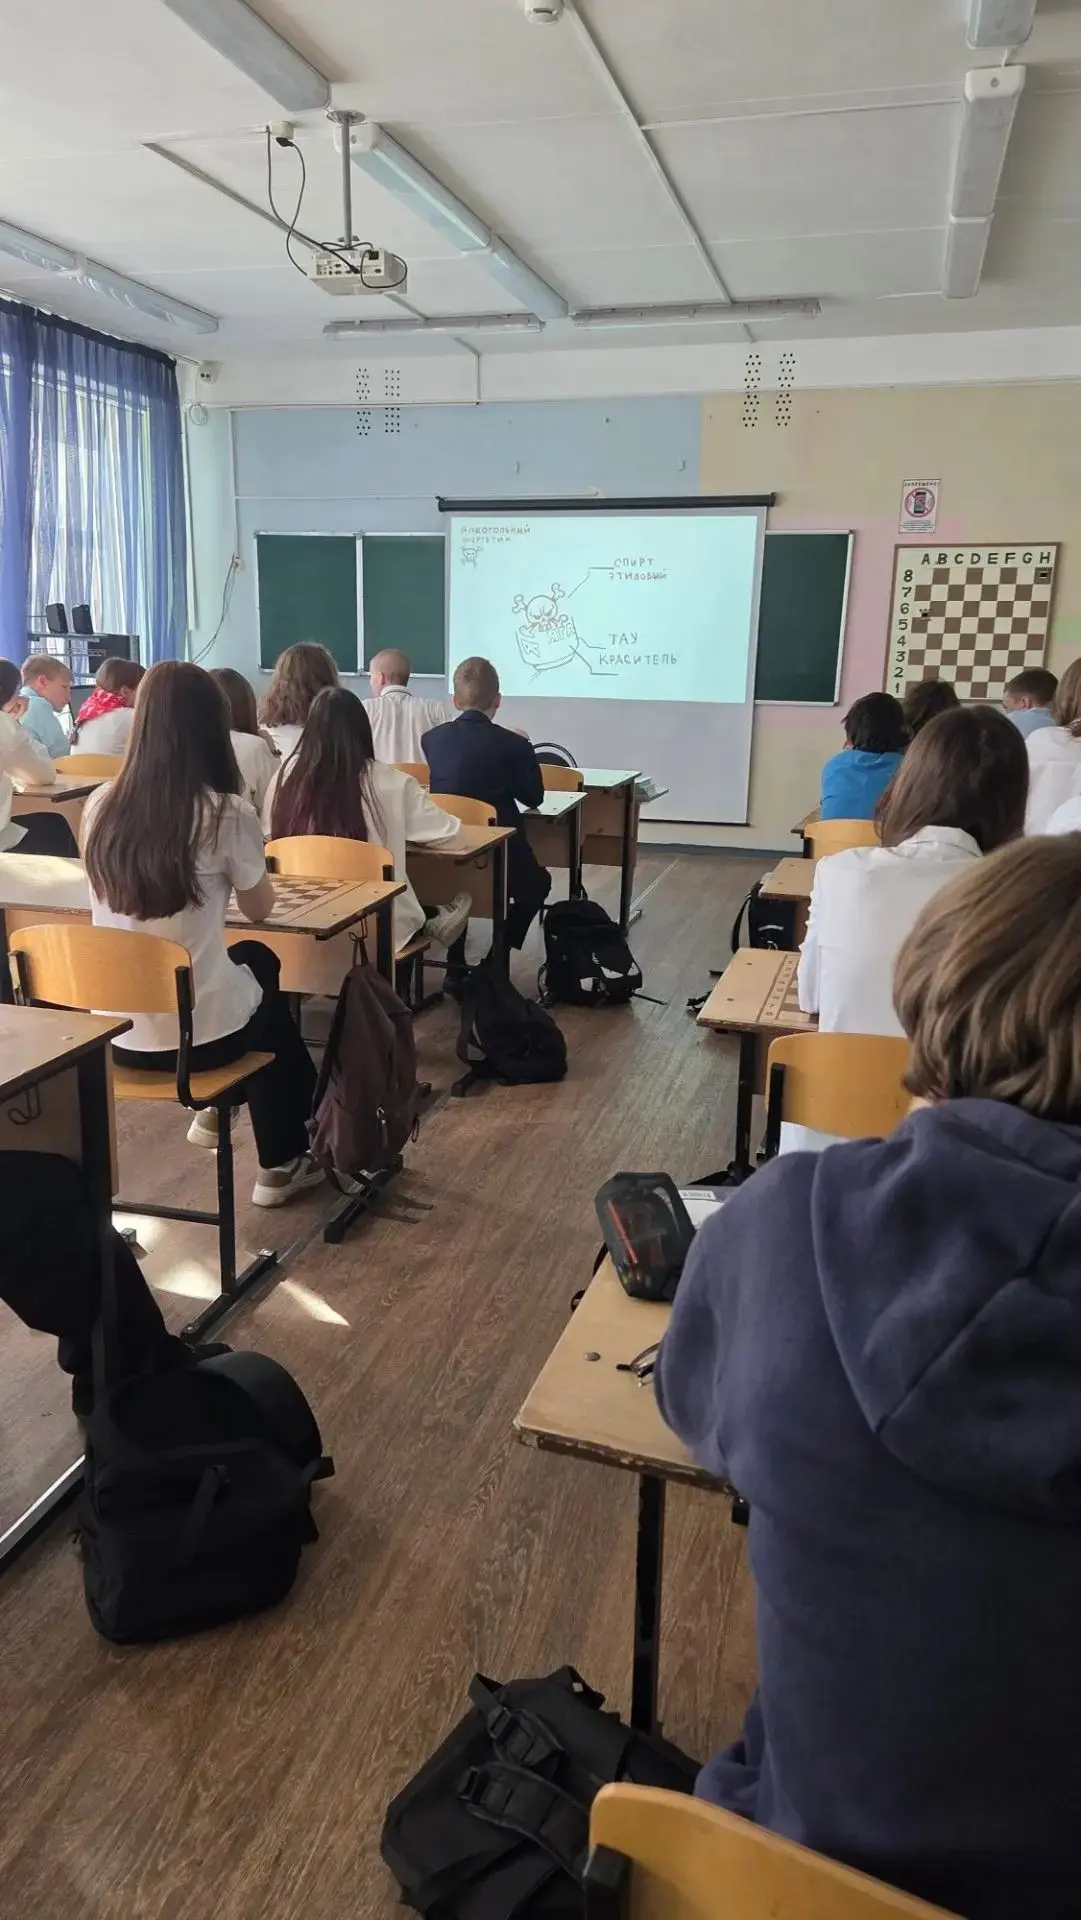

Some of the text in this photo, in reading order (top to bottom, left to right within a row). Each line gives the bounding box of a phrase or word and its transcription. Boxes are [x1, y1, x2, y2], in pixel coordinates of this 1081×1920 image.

[613, 557, 655, 568] СПИРТ
[921, 552, 1051, 565] A B C D E F G H
[608, 631, 639, 646] ТАУ
[893, 569, 913, 694] 8 7 6 5 4 3 2 1
[599, 652, 678, 666] КРАСИТЕЛЬ
